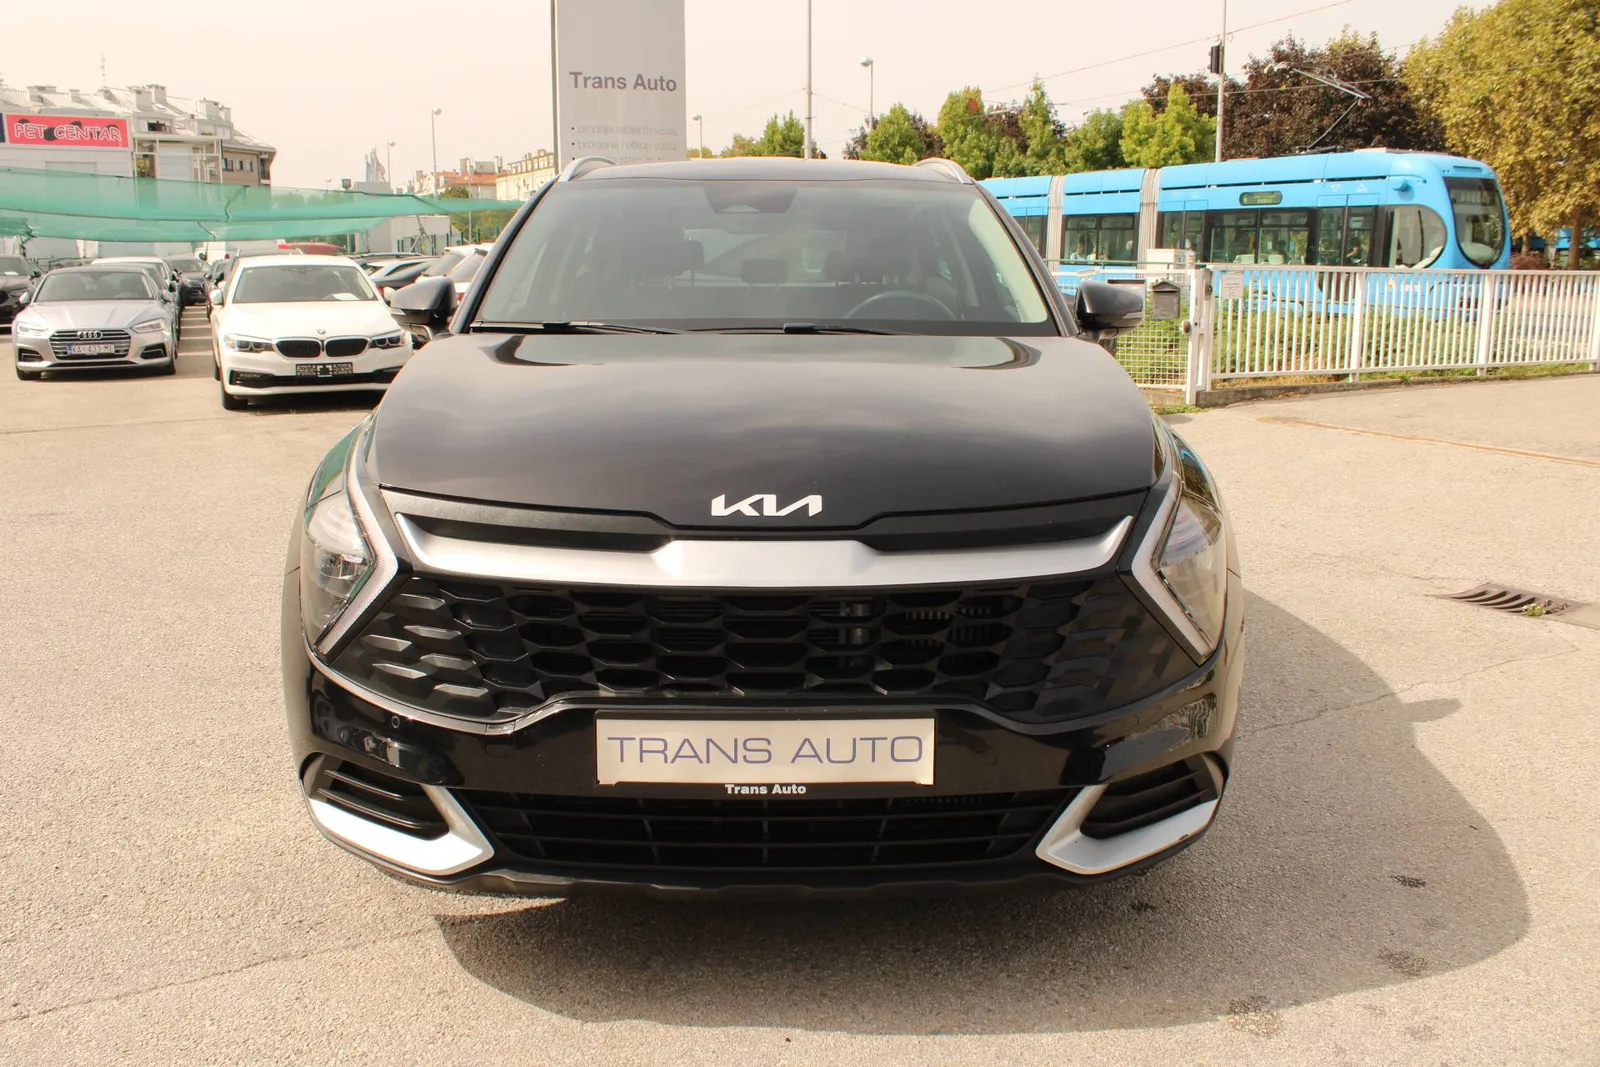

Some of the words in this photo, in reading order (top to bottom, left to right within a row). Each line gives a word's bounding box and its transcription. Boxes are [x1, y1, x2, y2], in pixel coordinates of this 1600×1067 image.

[569, 72, 627, 90] Trans
[633, 74, 677, 92] Auto
[14, 123, 47, 139] PET
[54, 124, 121, 141] CENTAR
[711, 493, 822, 517] KIA
[607, 736, 772, 765] TRANS
[791, 735, 924, 765] AUTO
[725, 783, 768, 795] Trans
[771, 783, 807, 795] Auto
